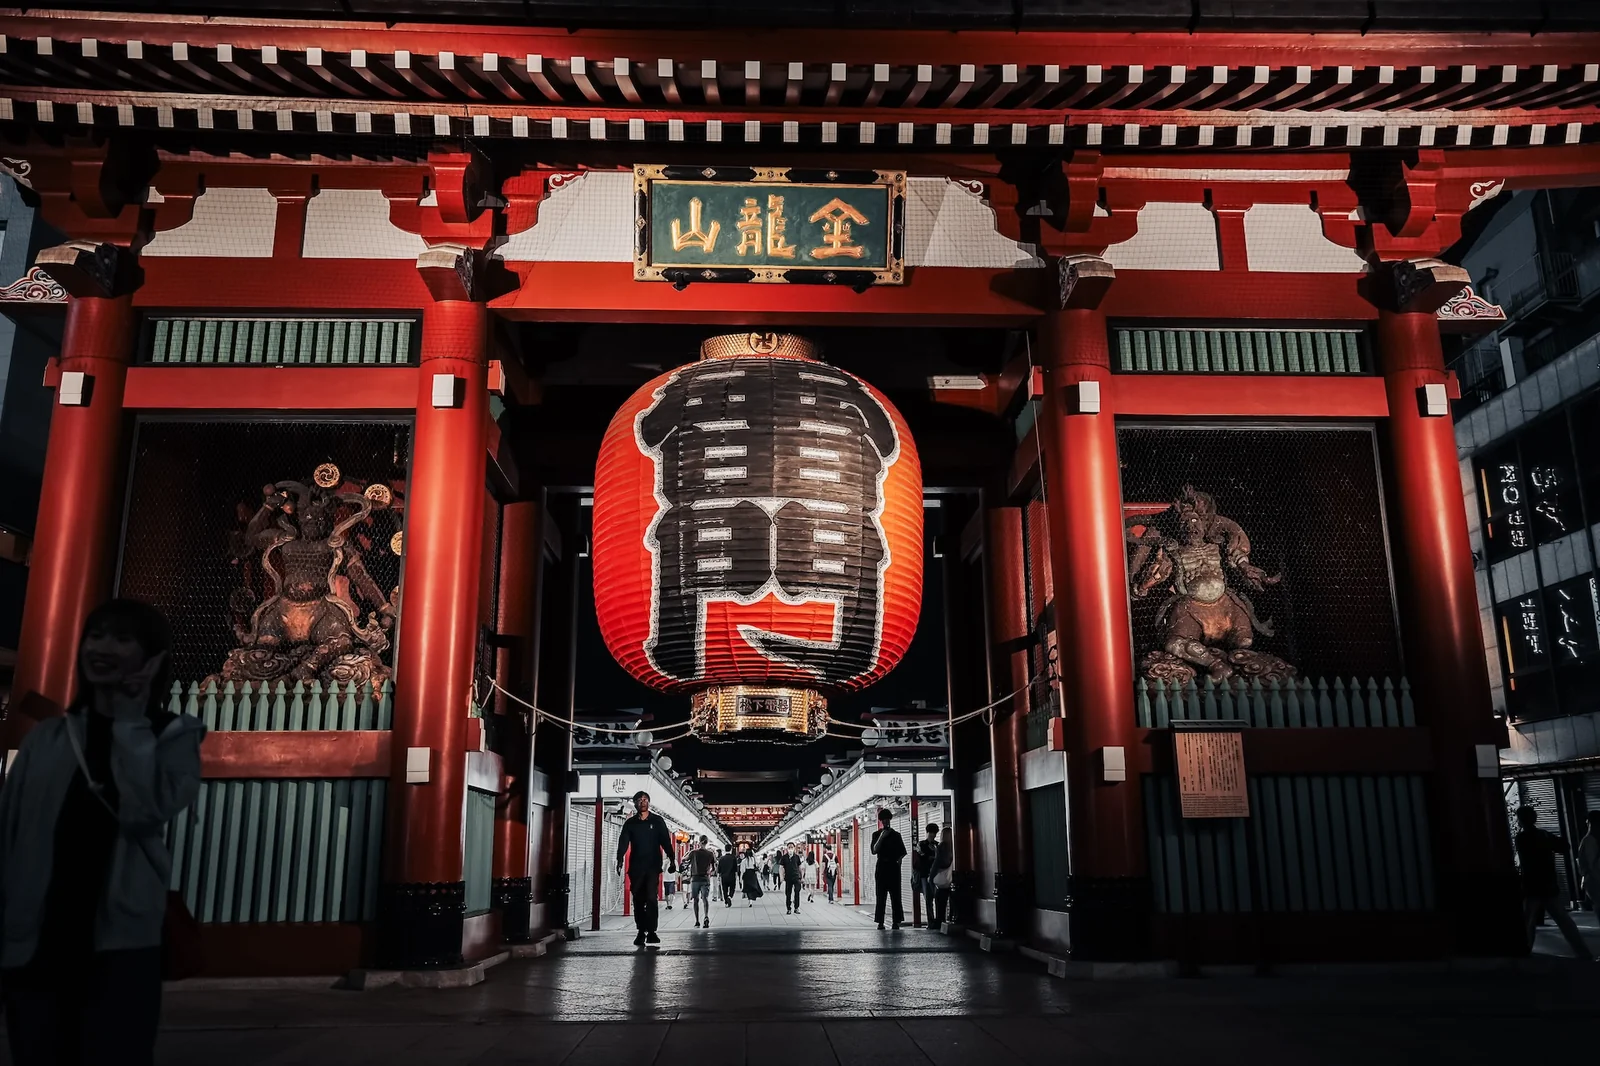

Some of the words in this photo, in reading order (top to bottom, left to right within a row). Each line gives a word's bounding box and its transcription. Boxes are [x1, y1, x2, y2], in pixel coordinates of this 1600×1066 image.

[671, 195, 869, 259] 金龍山
[634, 355, 900, 684] 雷門
[739, 698, 790, 712] 松下電器
